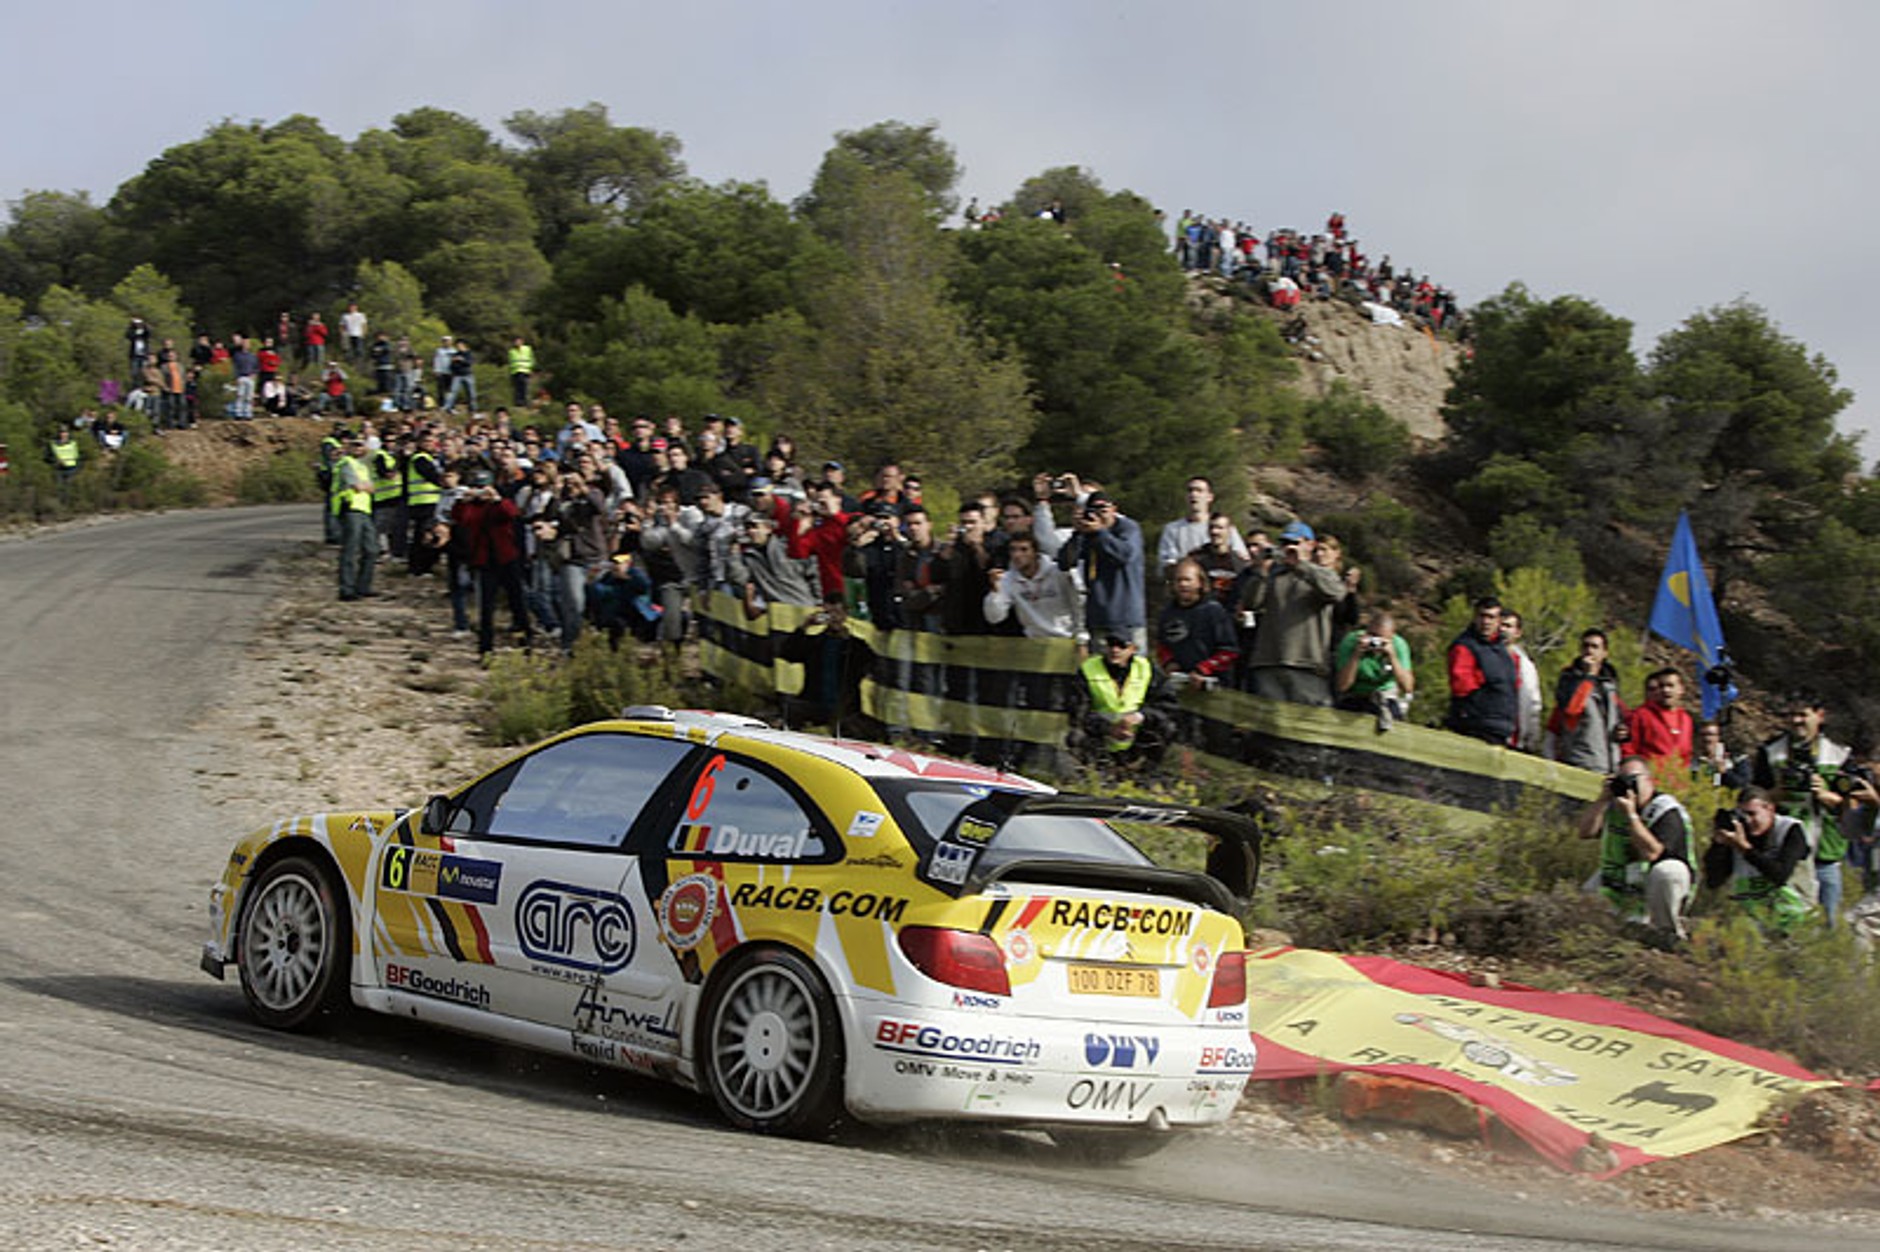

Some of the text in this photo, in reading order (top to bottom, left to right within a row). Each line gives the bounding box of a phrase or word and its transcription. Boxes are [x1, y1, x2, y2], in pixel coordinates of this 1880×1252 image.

[687, 753, 726, 821] 6
[712, 823, 809, 859] Duval
[388, 847, 406, 888] 6
[731, 883, 909, 923] RACB.COM
[1051, 899, 1194, 936] RACB.COM
[523, 893, 630, 963] arc
[385, 963, 491, 1005] BFGoodrich
[1072, 969, 1099, 991] 100
[876, 1019, 1042, 1059] BFGoodrich
[1066, 1078, 1155, 1111] OMV
